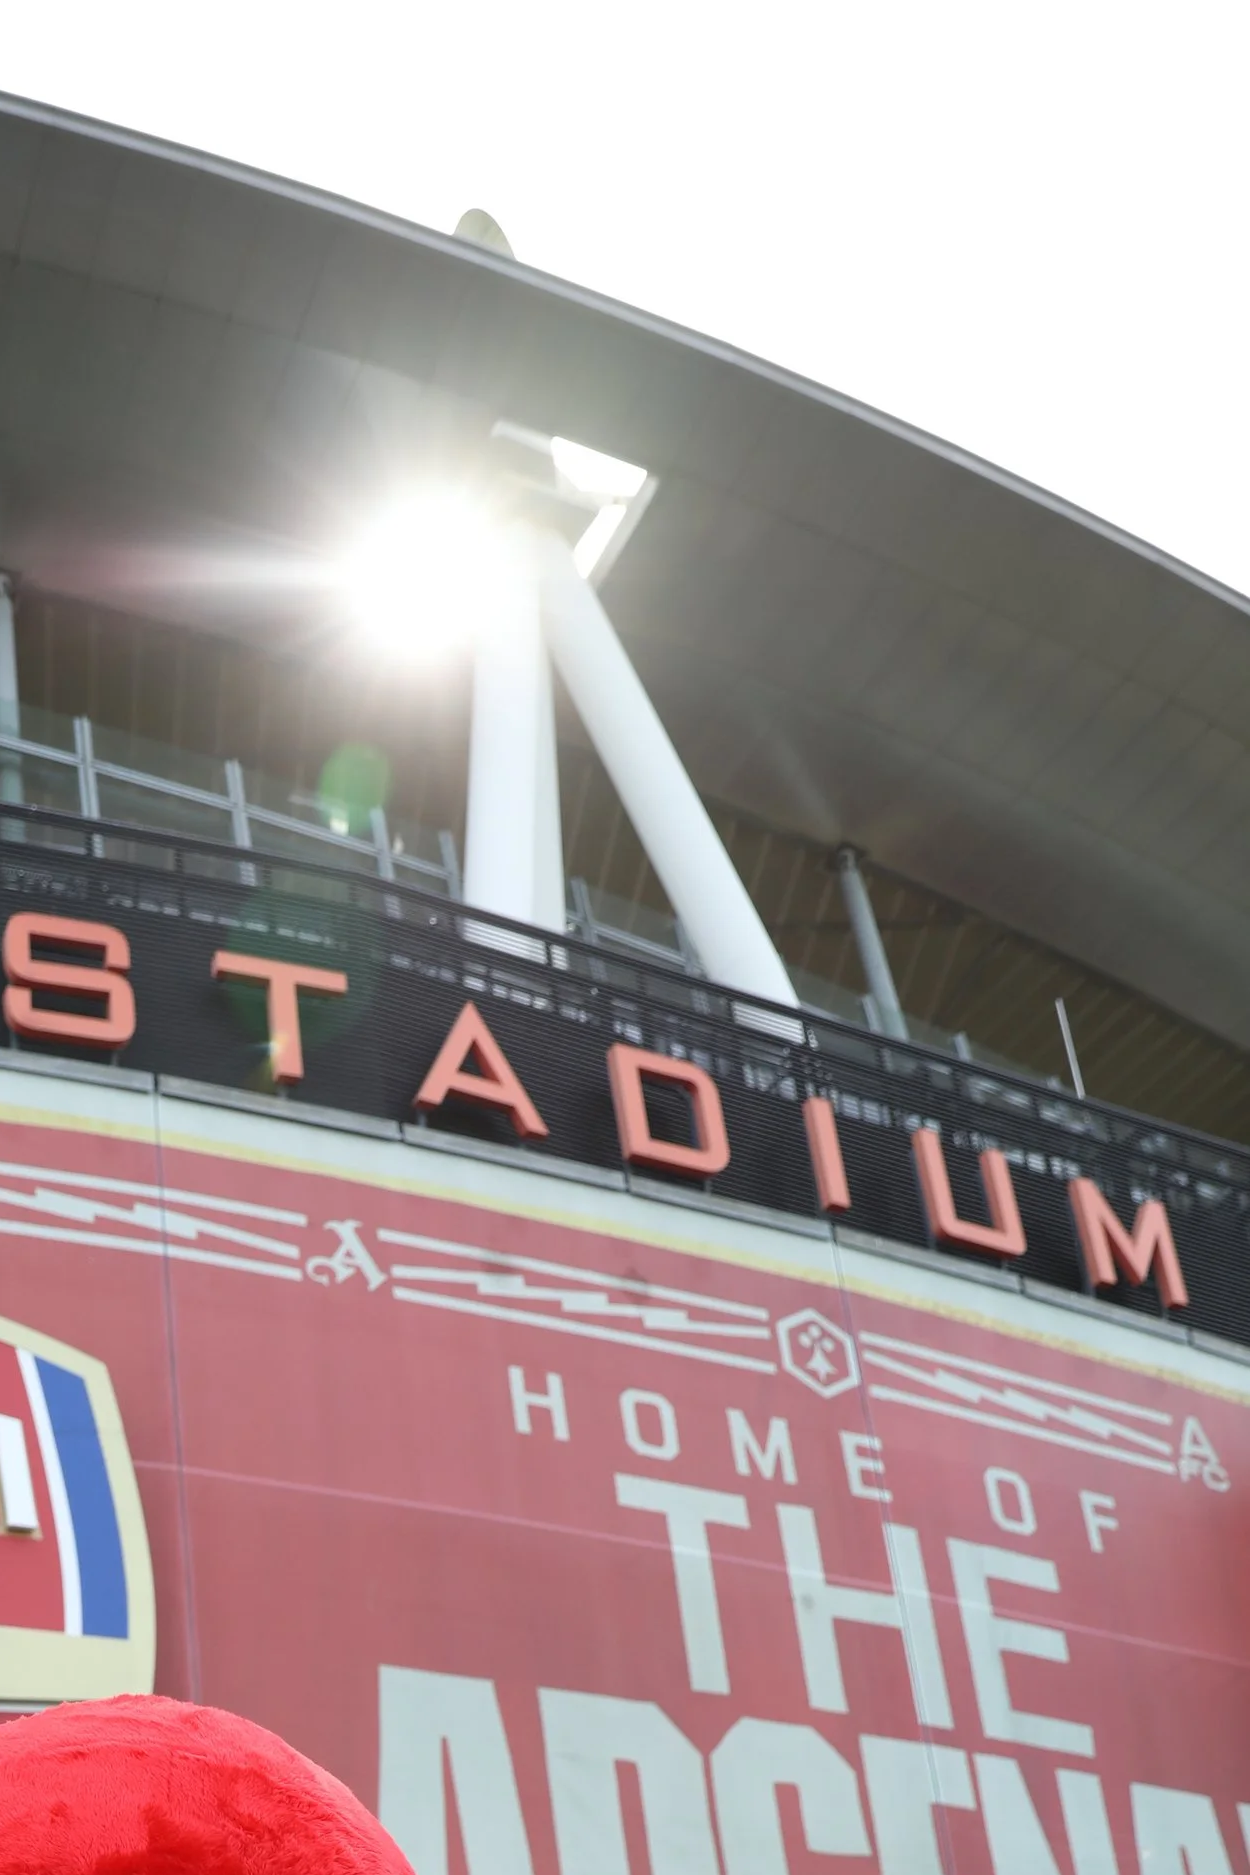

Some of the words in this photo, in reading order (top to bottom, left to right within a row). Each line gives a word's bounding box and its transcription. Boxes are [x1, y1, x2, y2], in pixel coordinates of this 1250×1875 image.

[2, 912, 1188, 1308] STADIUM
[508, 1365, 893, 1503] HOME
[984, 1466, 1120, 1553] OF
[613, 1472, 1096, 1758] THE
